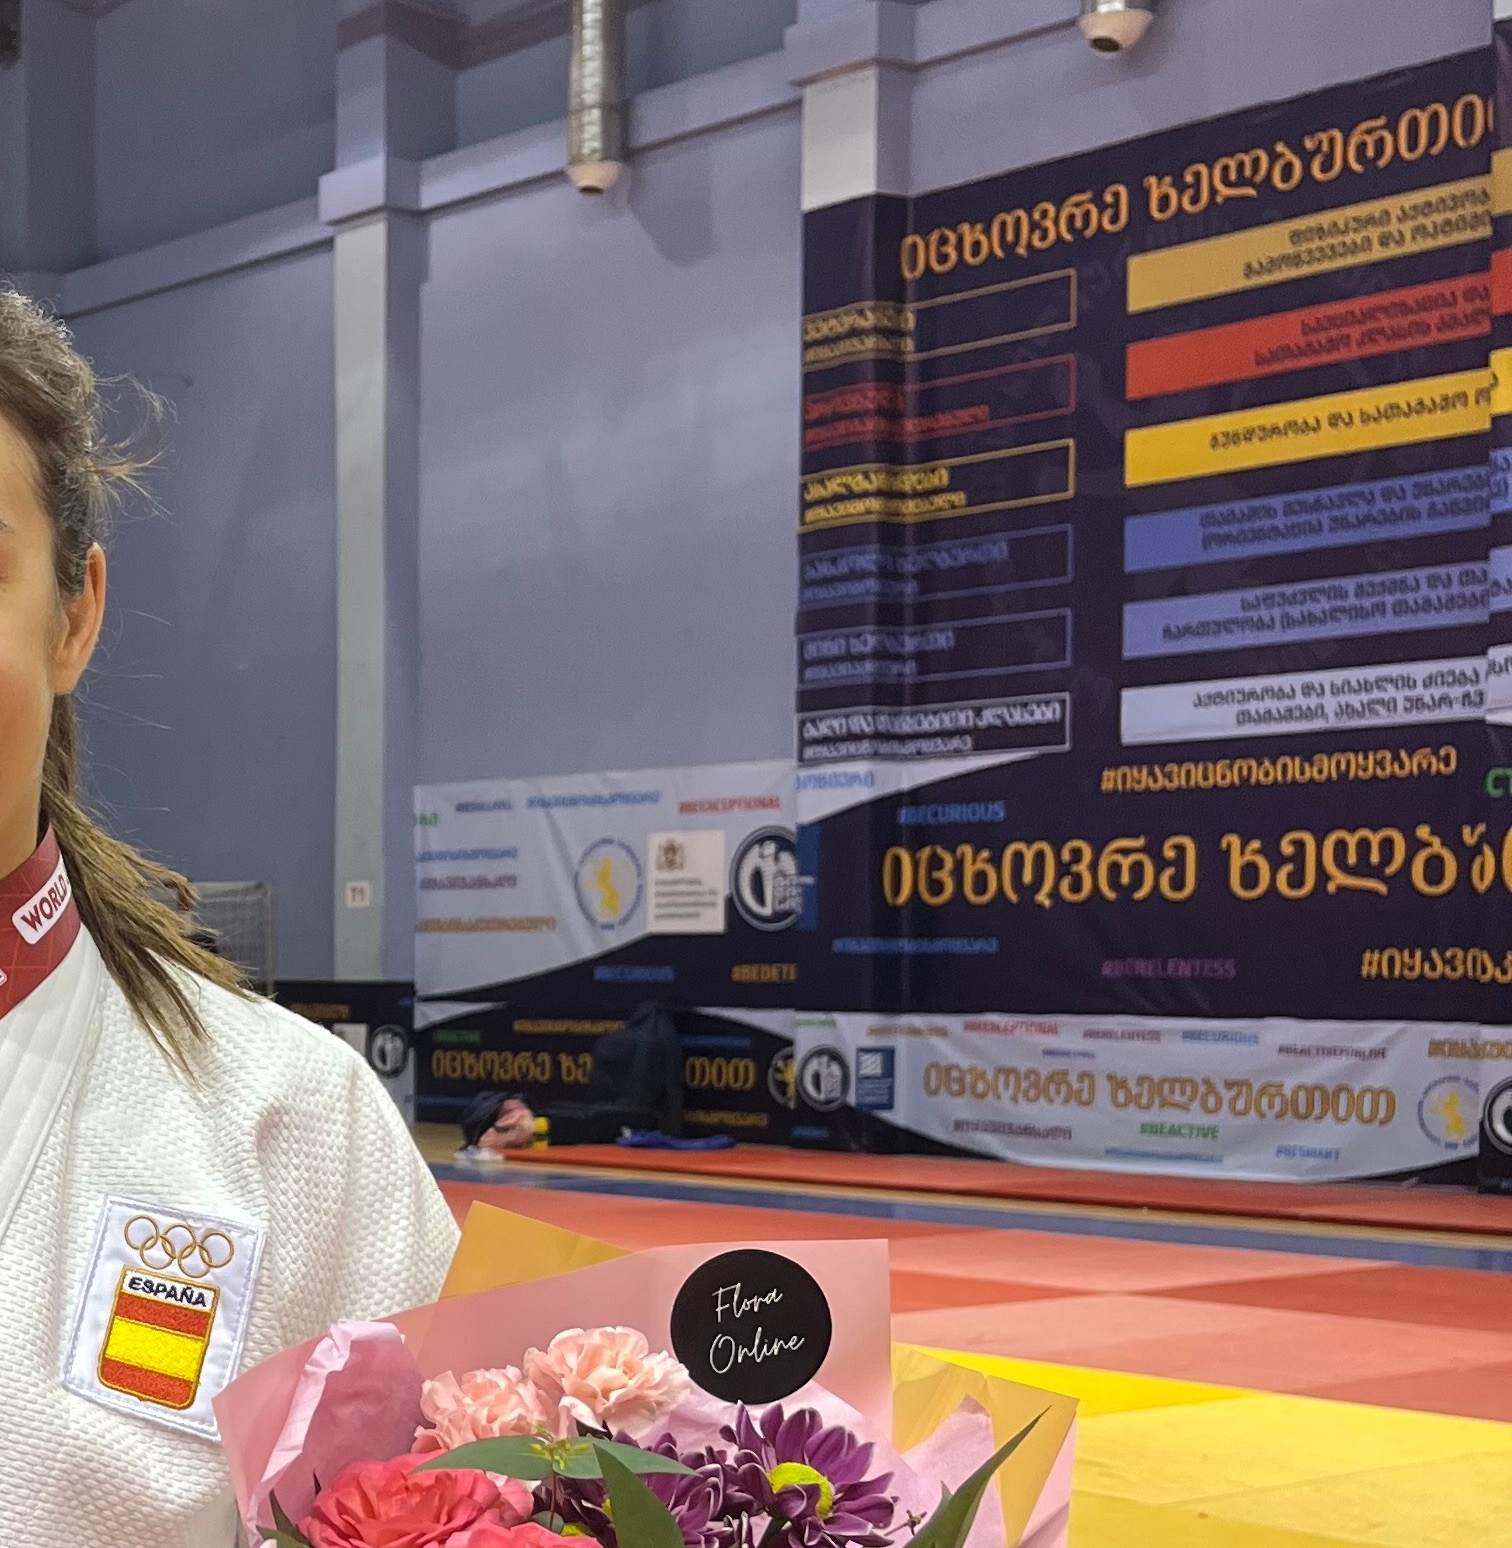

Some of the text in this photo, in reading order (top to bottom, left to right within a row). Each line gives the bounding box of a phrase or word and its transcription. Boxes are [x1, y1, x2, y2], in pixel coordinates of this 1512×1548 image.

[899, 94, 1494, 280] იცხოვრე ხელბურთი
[882, 835, 1198, 908] იცხოვრე
[20, 874, 68, 932] WORLD
[128, 1275, 206, 1308] ESPAÑA
[712, 1282, 783, 1323] Flora
[709, 1326, 805, 1373] Online
